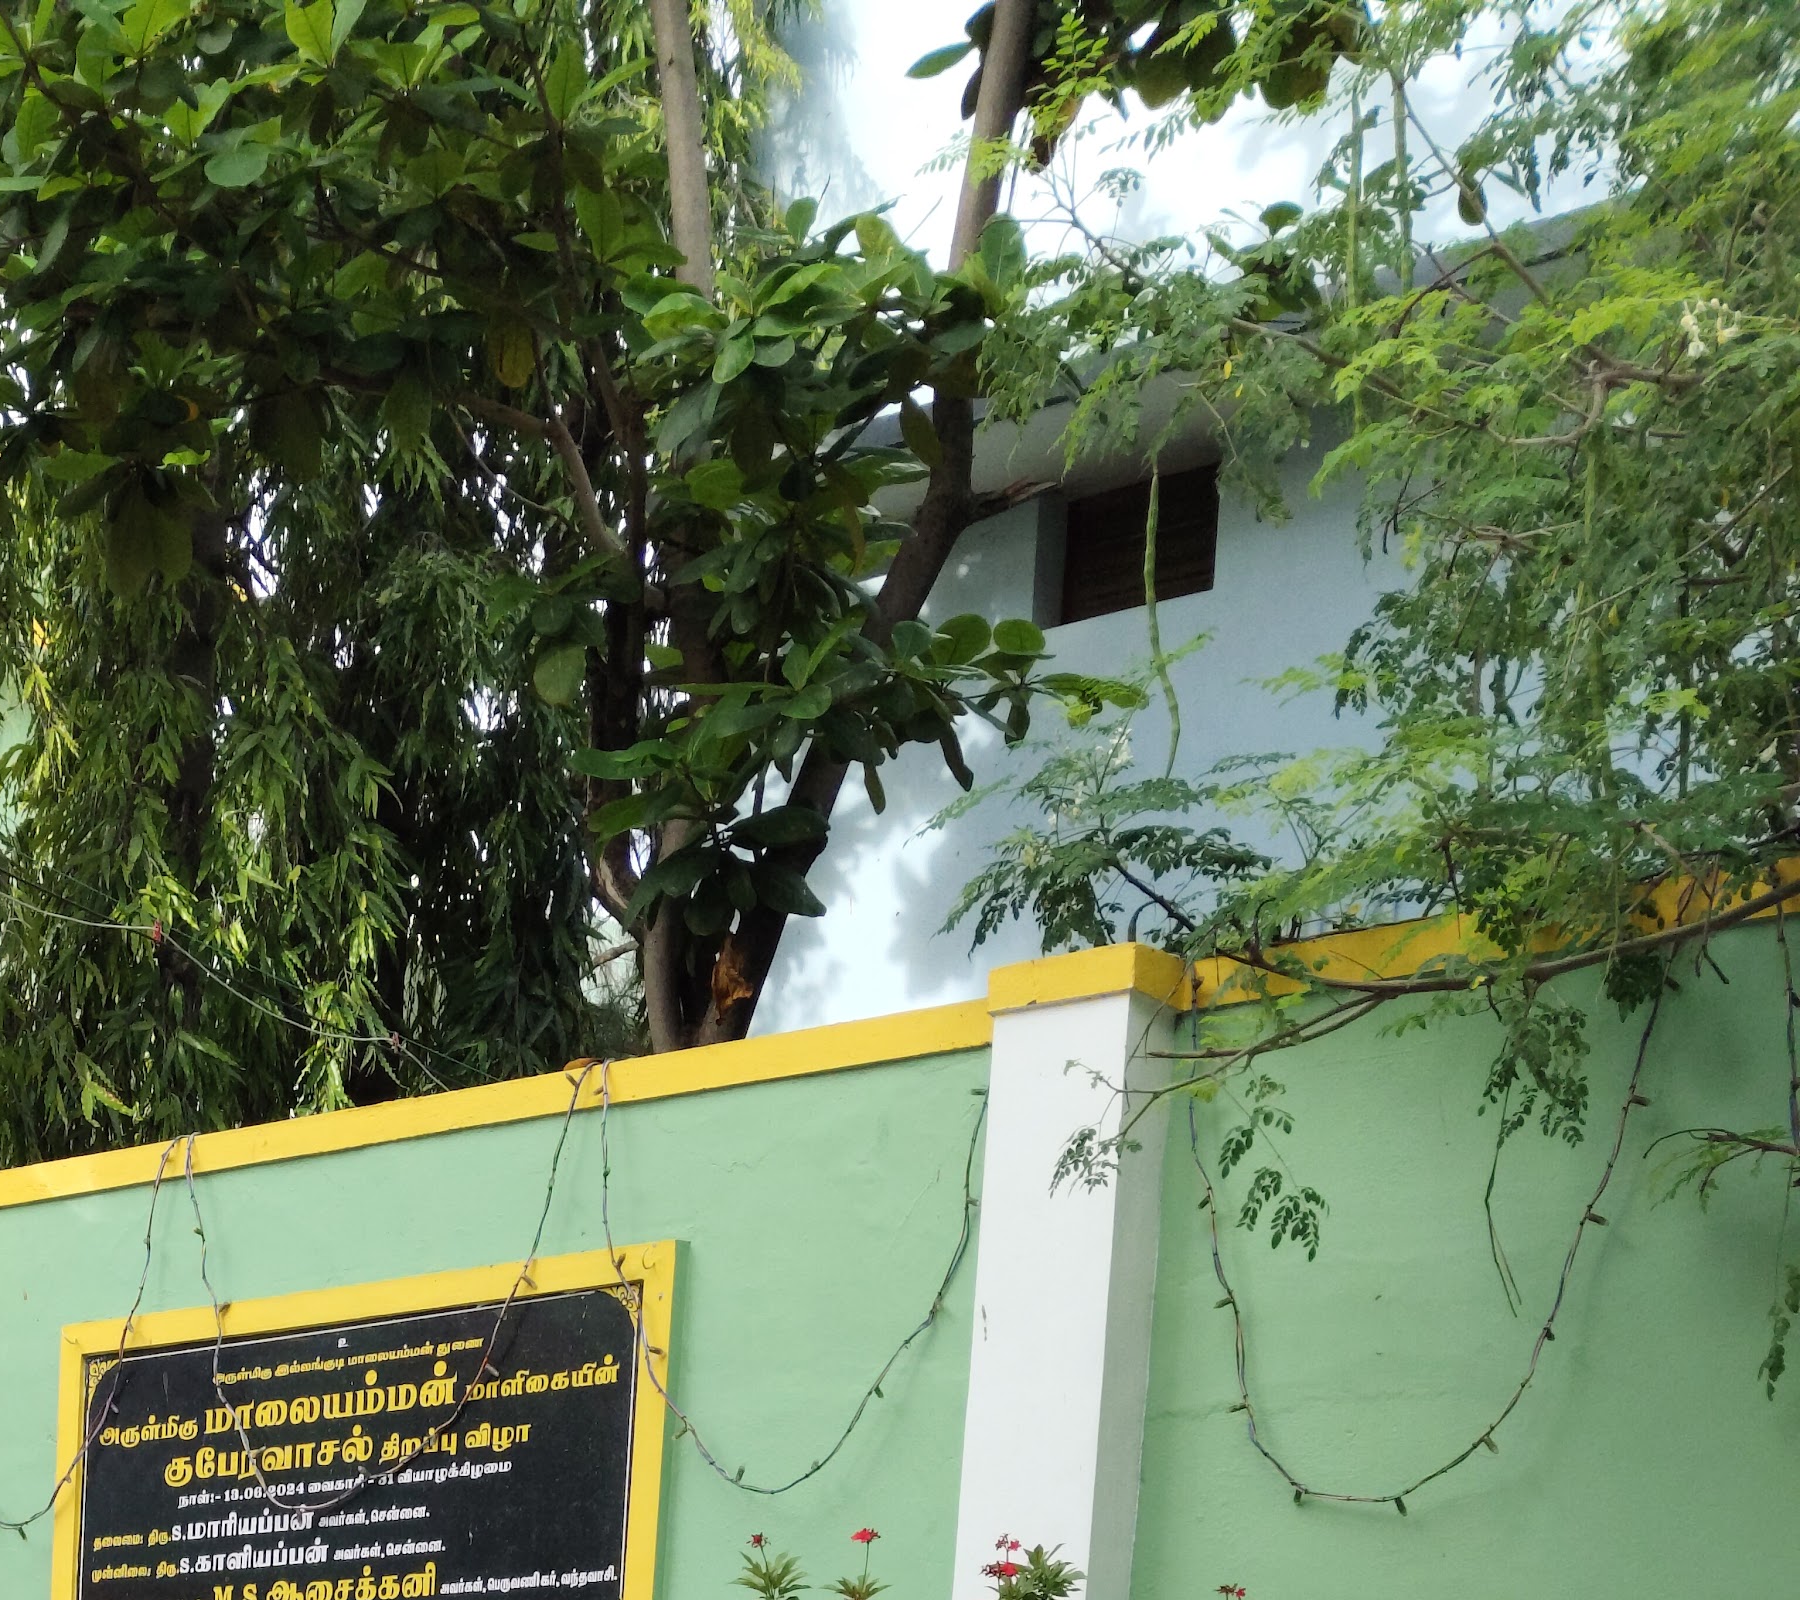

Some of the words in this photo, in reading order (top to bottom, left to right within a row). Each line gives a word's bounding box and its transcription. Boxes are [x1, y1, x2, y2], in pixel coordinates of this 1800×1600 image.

[347, 1341, 434, 1366] மாலையம்மன்
[436, 1337, 484, 1356] துணை
[100, 1414, 198, 1447] அருள்மிகு
[204, 1361, 458, 1435] மாலையம்மன்
[465, 1354, 620, 1402] மாளிகையின்
[164, 1424, 373, 1488] குபேரவாசல்
[379, 1427, 458, 1464] திறப்பு
[465, 1422, 532, 1451] விழா
[397, 1460, 512, 1485] வியாழக்கிழமை
